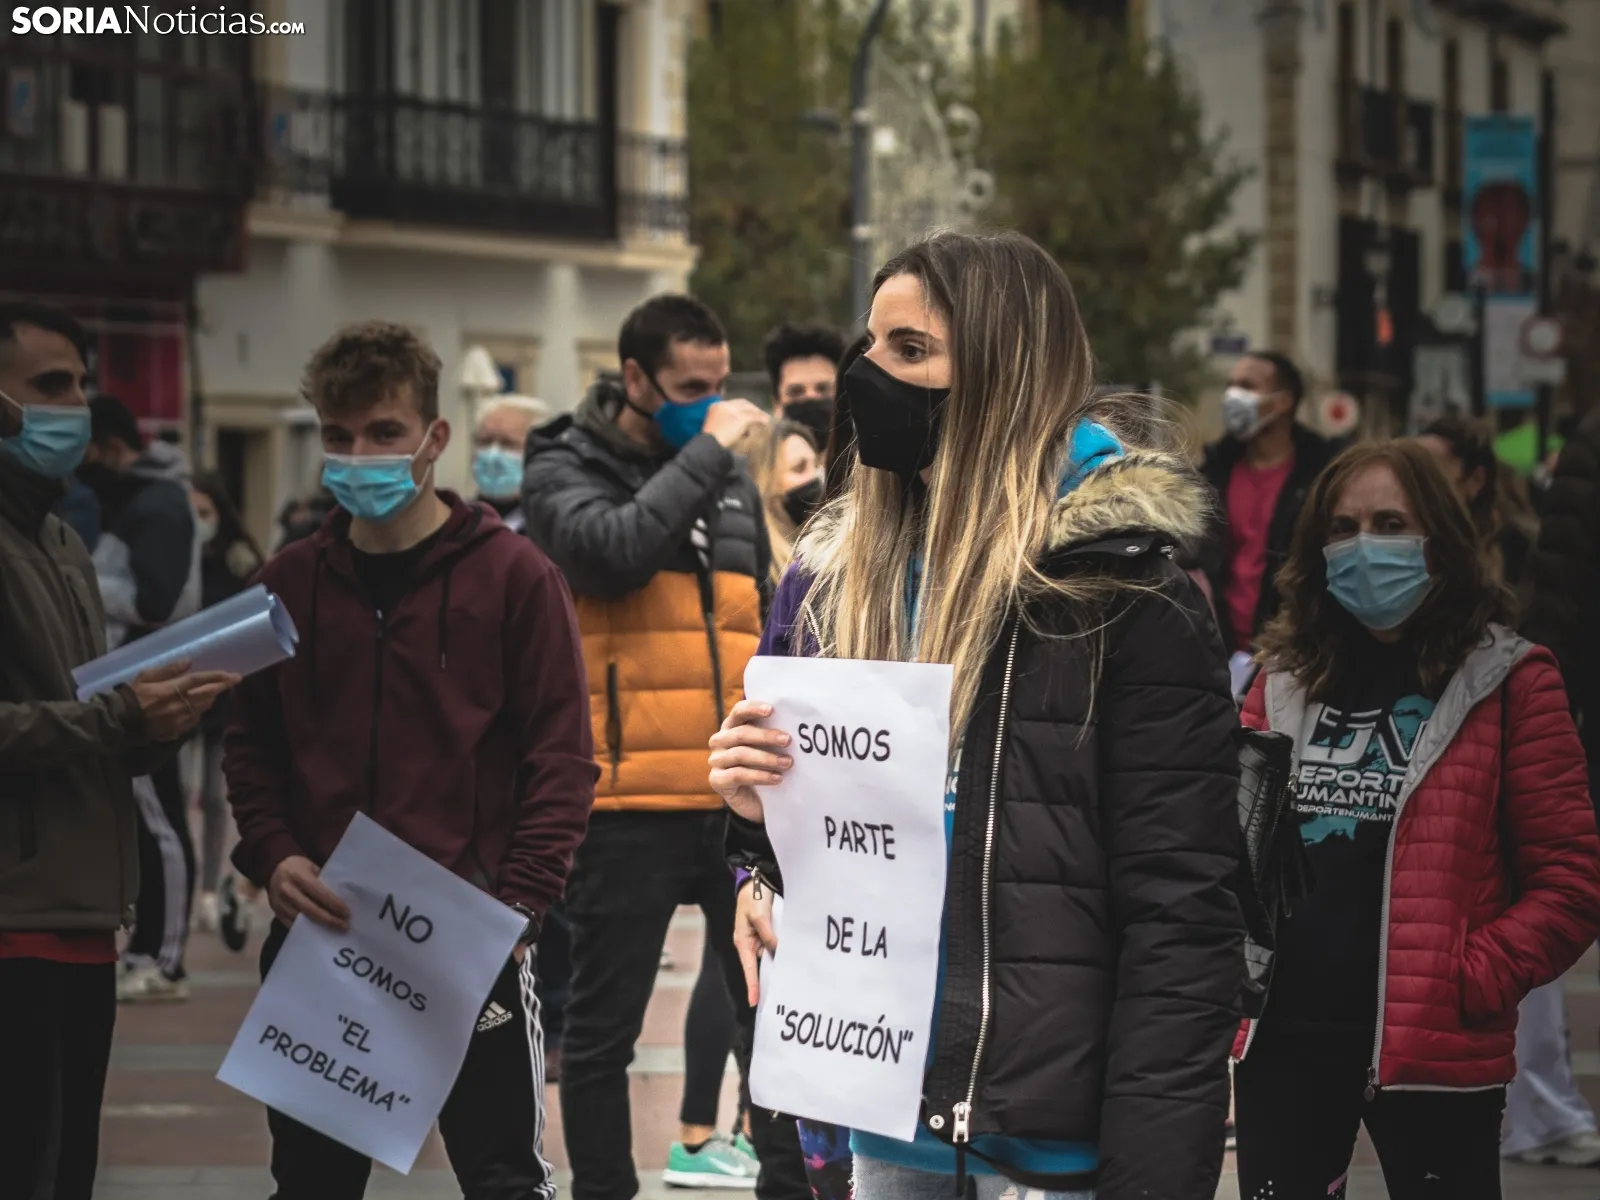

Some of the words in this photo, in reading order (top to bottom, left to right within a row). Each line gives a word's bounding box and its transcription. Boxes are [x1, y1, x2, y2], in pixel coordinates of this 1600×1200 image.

[798, 722, 890, 762] SOMOS
[824, 815, 896, 860] PARTE
[379, 893, 434, 944] NO
[826, 914, 855, 954] DE
[861, 921, 888, 959] LA
[333, 947, 428, 1012] SOMOS
[476, 1010, 513, 1032] adidas
